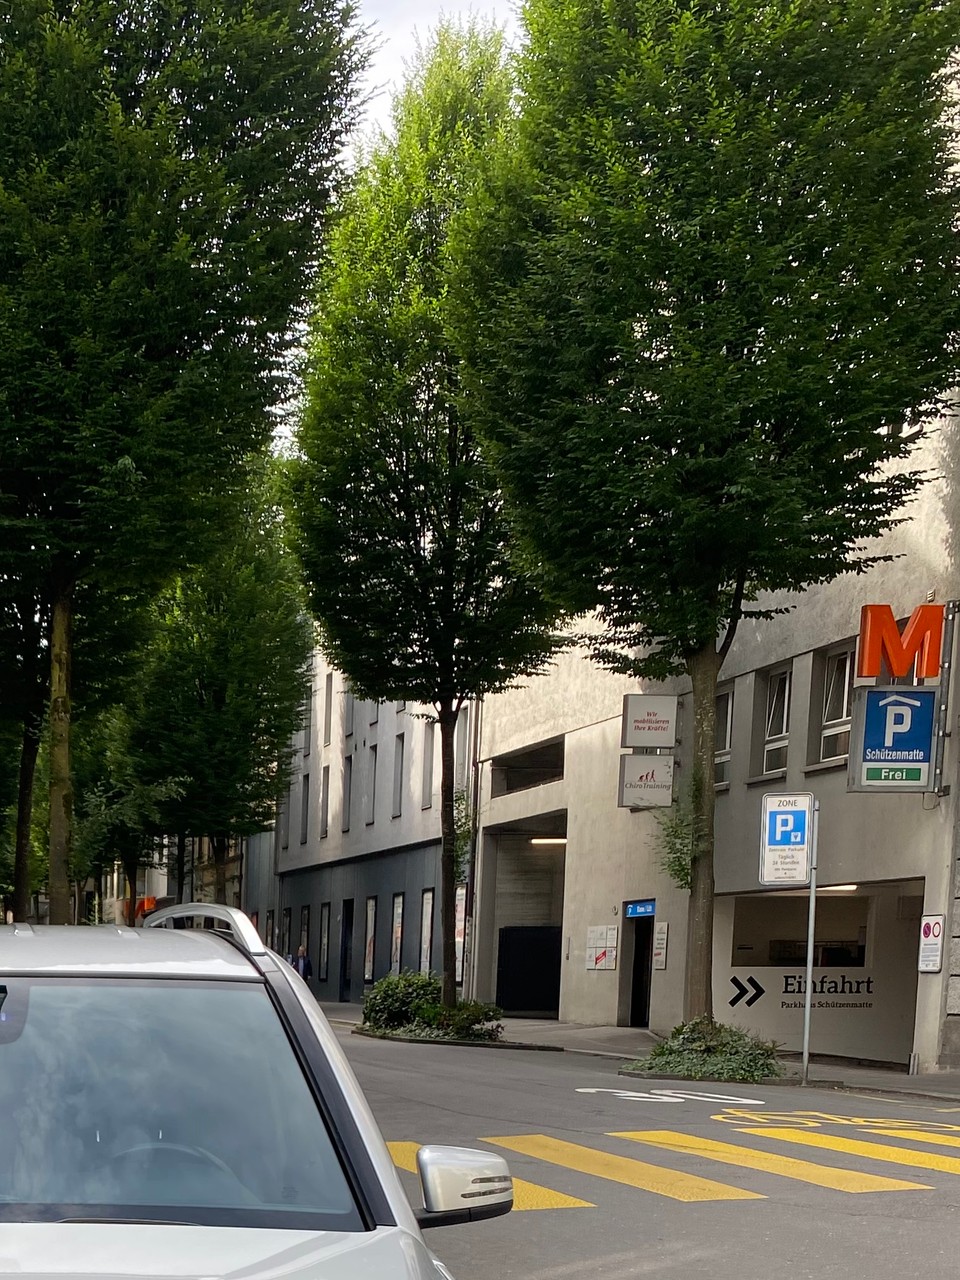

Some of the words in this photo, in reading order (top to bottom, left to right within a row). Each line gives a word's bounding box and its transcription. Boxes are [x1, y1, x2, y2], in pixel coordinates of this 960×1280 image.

[857, 604, 945, 678] M
[884, 705, 912, 747] P
[866, 748, 924, 760] Schützenmatte
[881, 768, 907, 780] Frei
[777, 799, 798, 807] ZONE
[775, 814, 794, 841] P
[782, 975, 874, 994] Einfahrt
[817, 1000, 873, 1009] Schützenmatte
